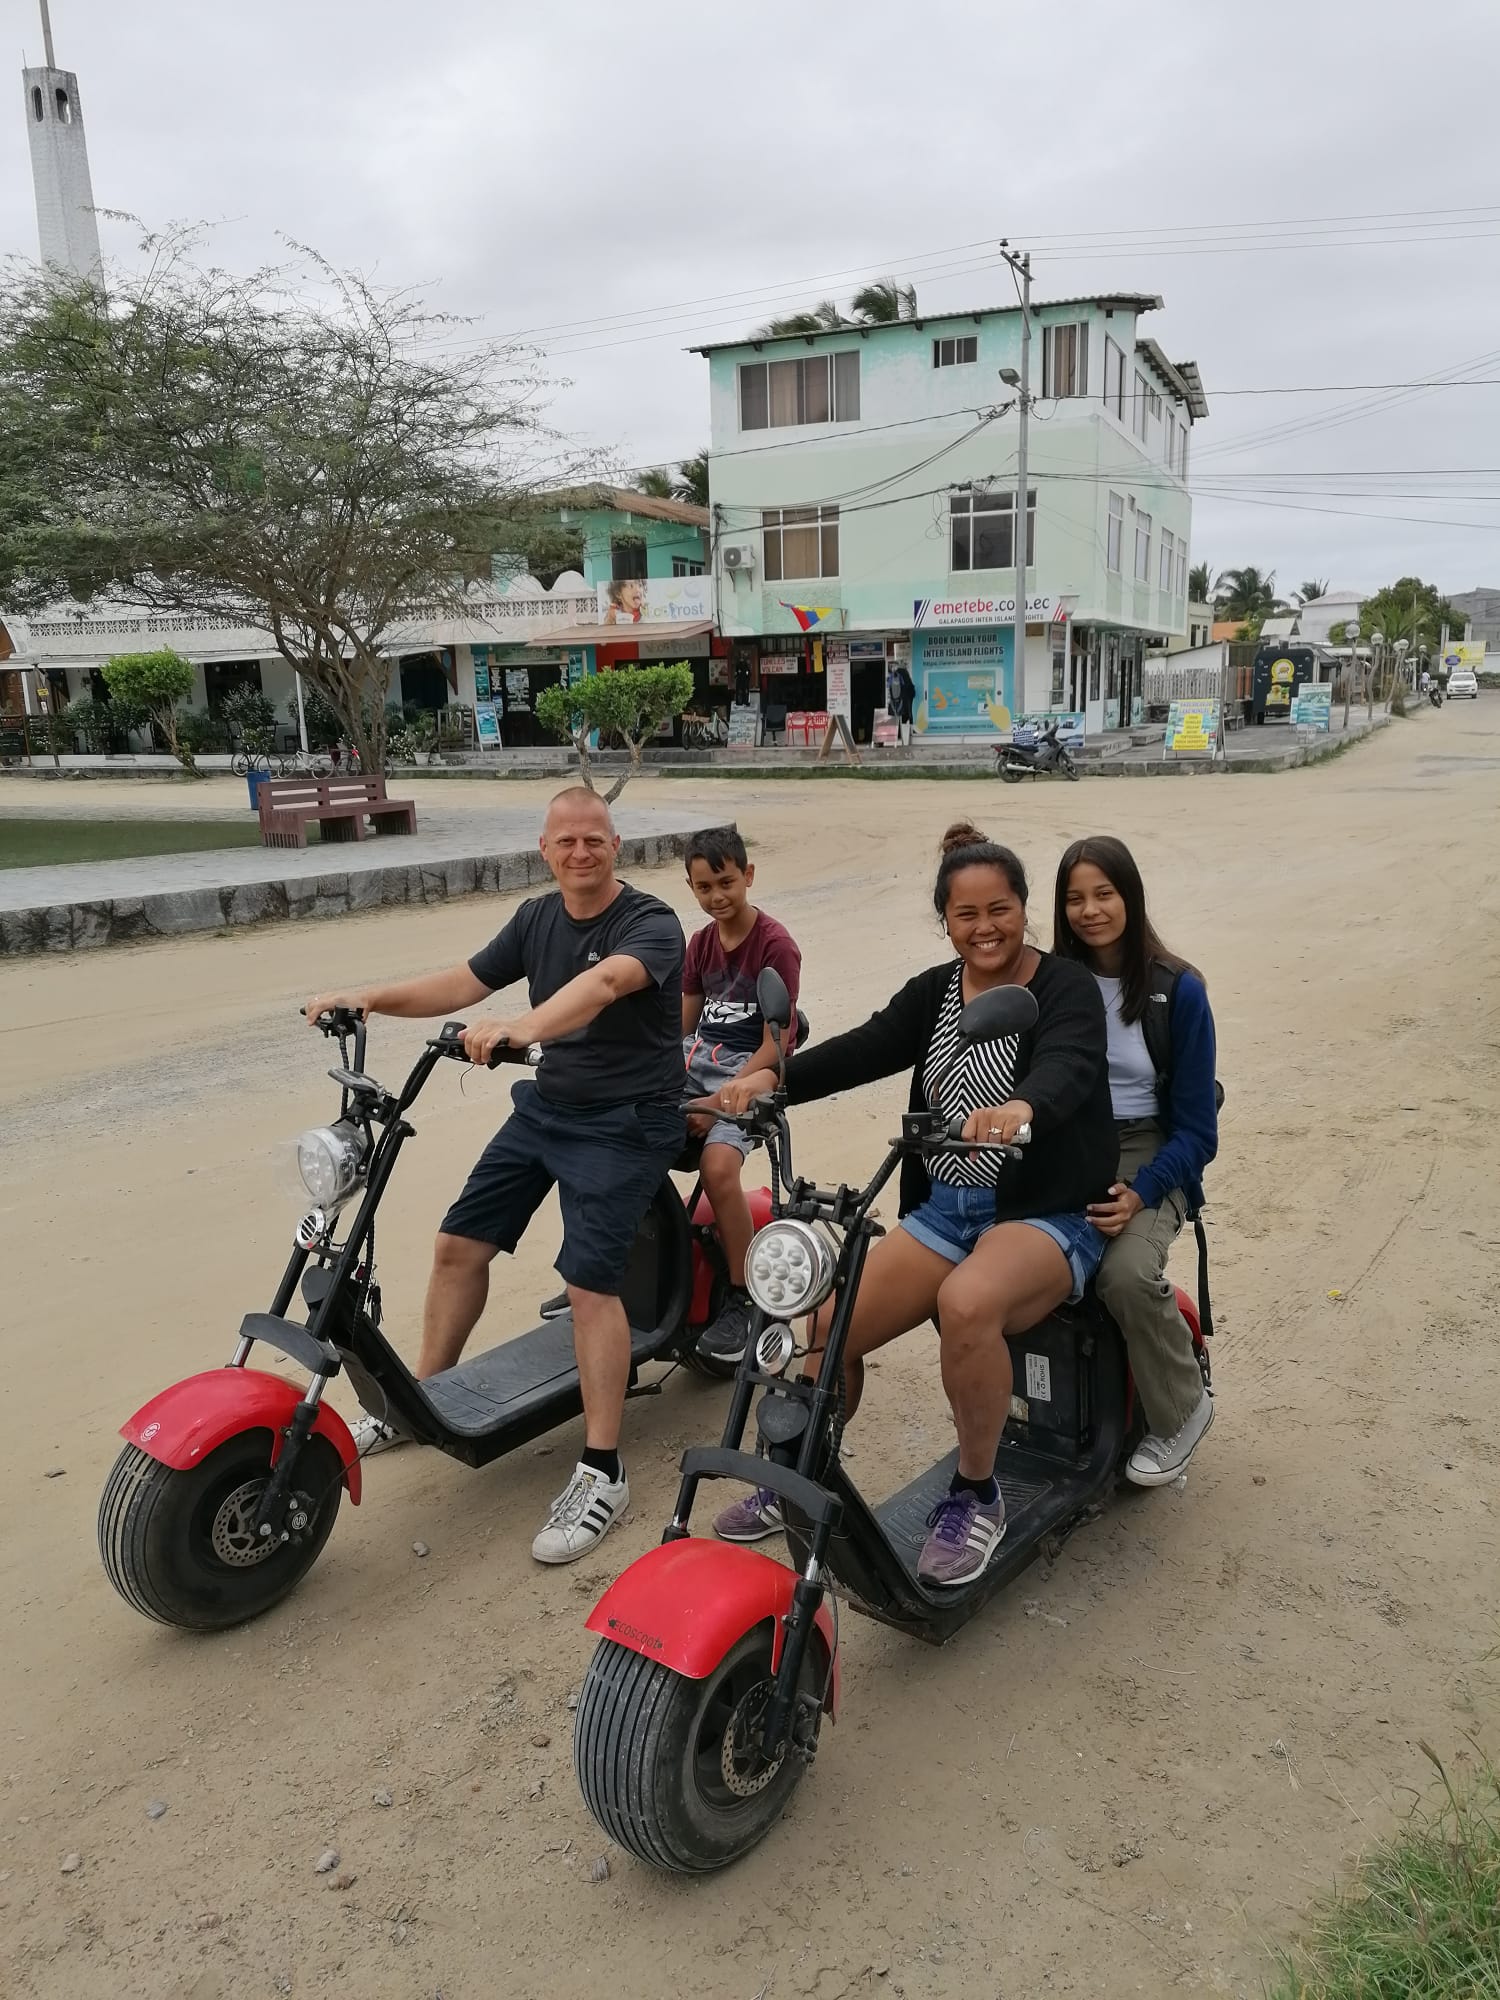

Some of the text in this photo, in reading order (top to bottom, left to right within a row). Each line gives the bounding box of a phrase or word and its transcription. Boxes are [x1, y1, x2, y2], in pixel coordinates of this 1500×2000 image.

[938, 616, 974, 625] GALAPAGOS
[975, 615, 992, 624] INTER
[928, 634, 997, 646] BOOK ONLINE YOUR
[923, 646, 1004, 658] INTER ISLAND FLIGHTS
